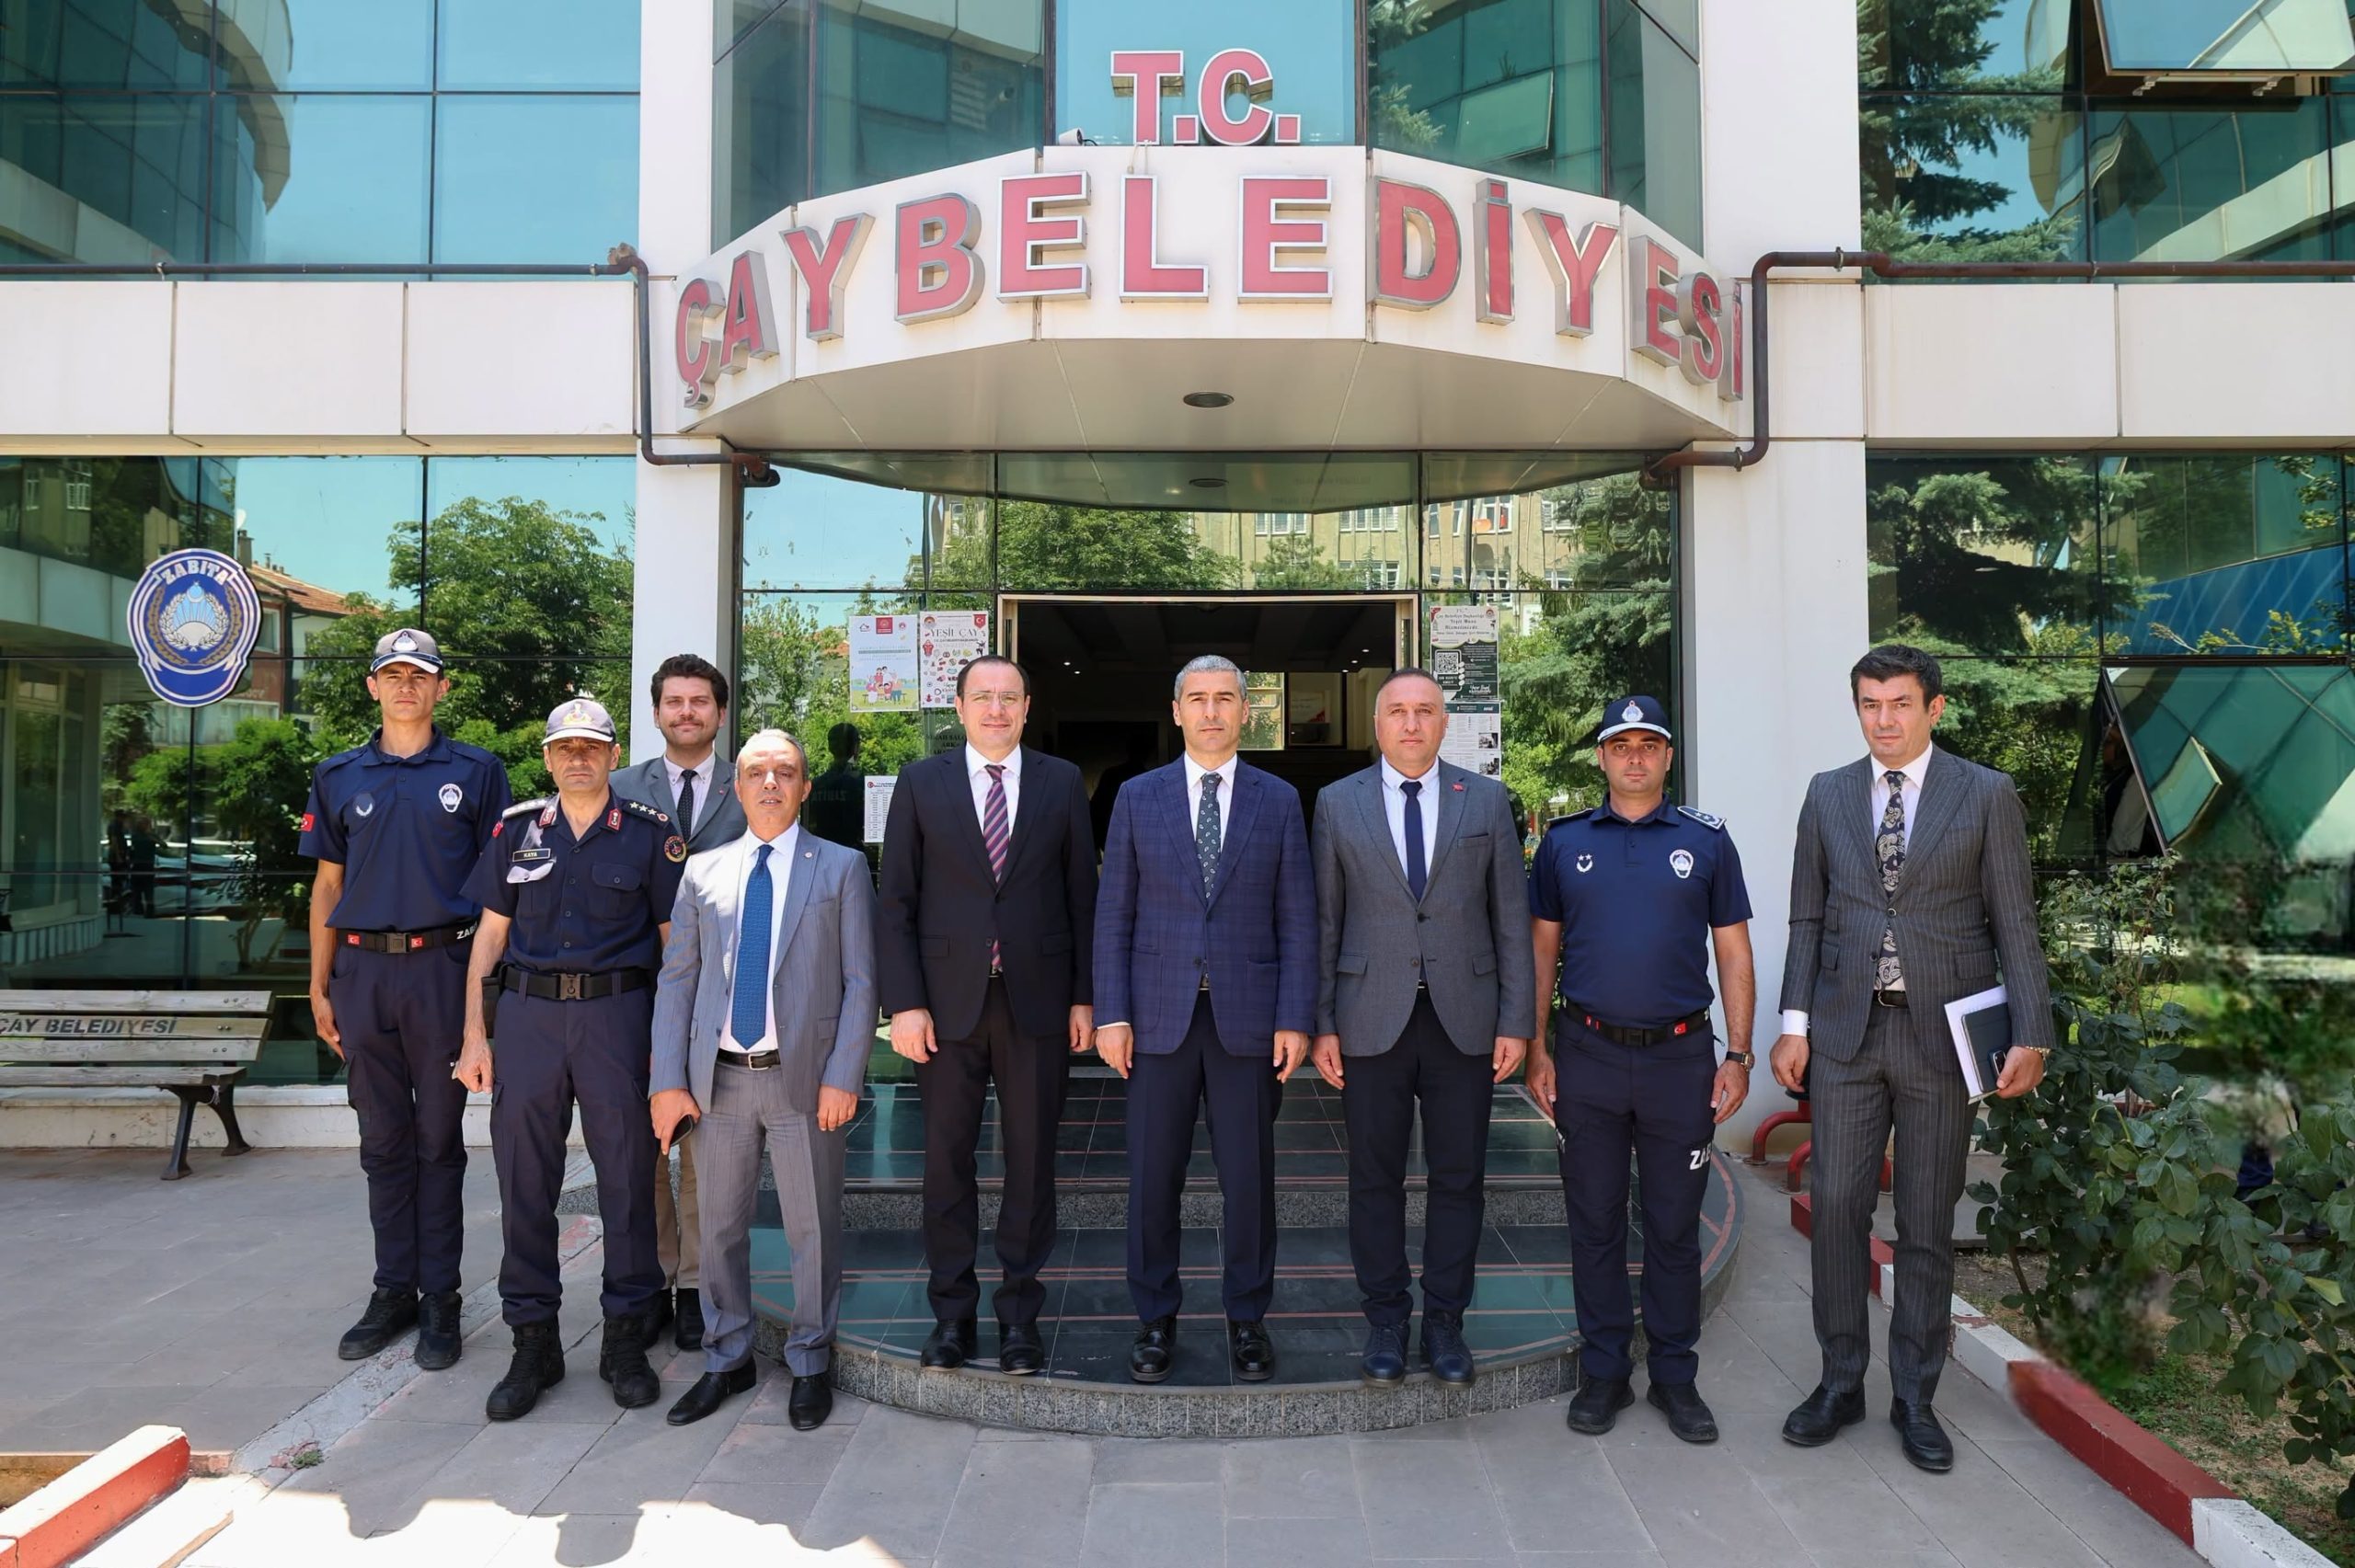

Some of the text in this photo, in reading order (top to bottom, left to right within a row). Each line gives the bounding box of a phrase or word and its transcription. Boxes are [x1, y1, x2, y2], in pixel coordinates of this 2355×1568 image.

[1110, 48, 1301, 146] T.C.
[676, 171, 1743, 409] ÇAY BELEDİYESİ
[161, 560, 229, 585] ZABITA
